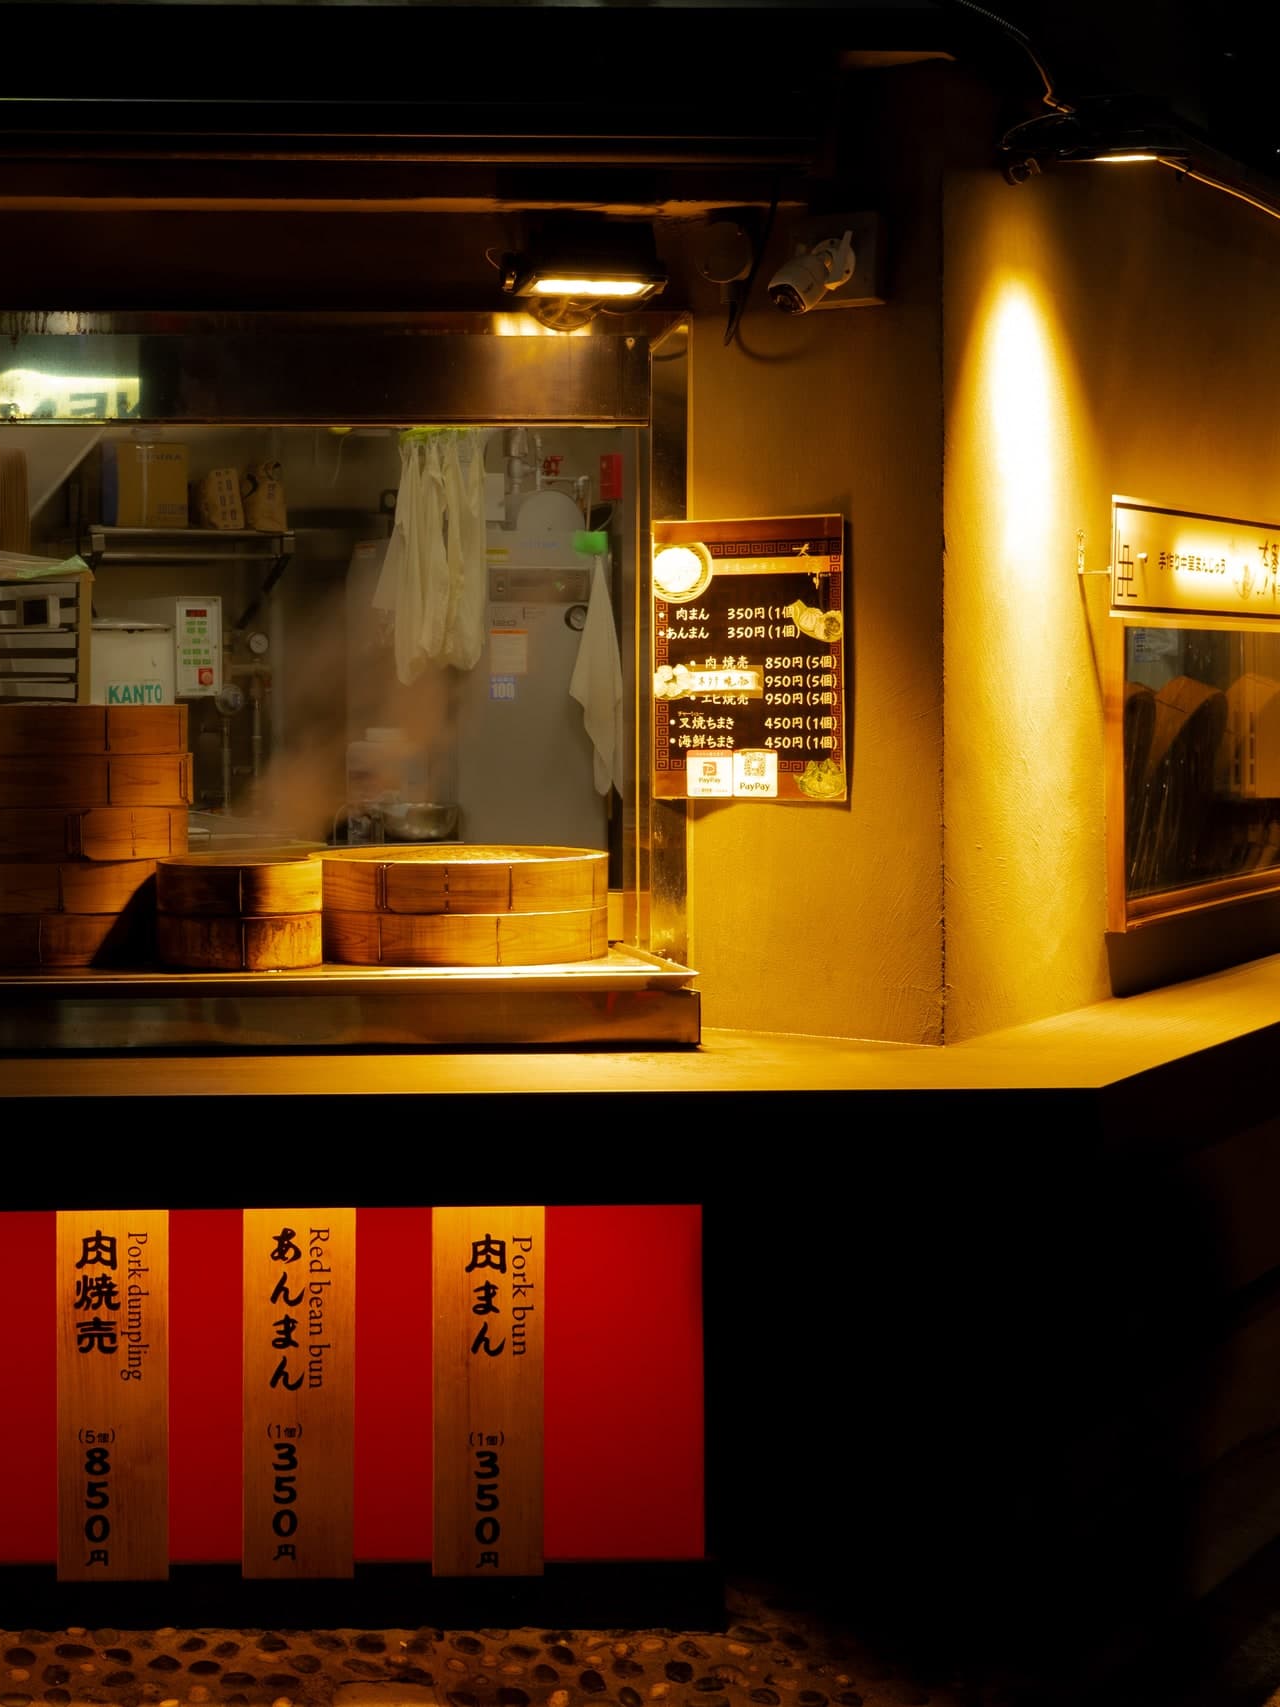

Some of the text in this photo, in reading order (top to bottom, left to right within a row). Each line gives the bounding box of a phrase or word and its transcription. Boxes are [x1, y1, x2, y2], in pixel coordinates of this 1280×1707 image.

[665, 626, 709, 640] あんまん
[676, 607, 710, 621] 肉まん
[108, 684, 162, 704] KANTO
[678, 716, 735, 730] 叉焼ちまき
[678, 734, 735, 749] 海鮮ちまき
[740, 782, 770, 791] PayPay
[120, 1231, 150, 1381] Pork dumpling
[309, 1227, 331, 1389] Red bean bun
[512, 1236, 535, 1356] Pork bun
[73, 1229, 121, 1567] 肉焼売 (5個) 850円
[266, 1227, 306, 1561] あんまん (1個) 350円
[465, 1233, 509, 1569] 肉まん (1個) 350円
